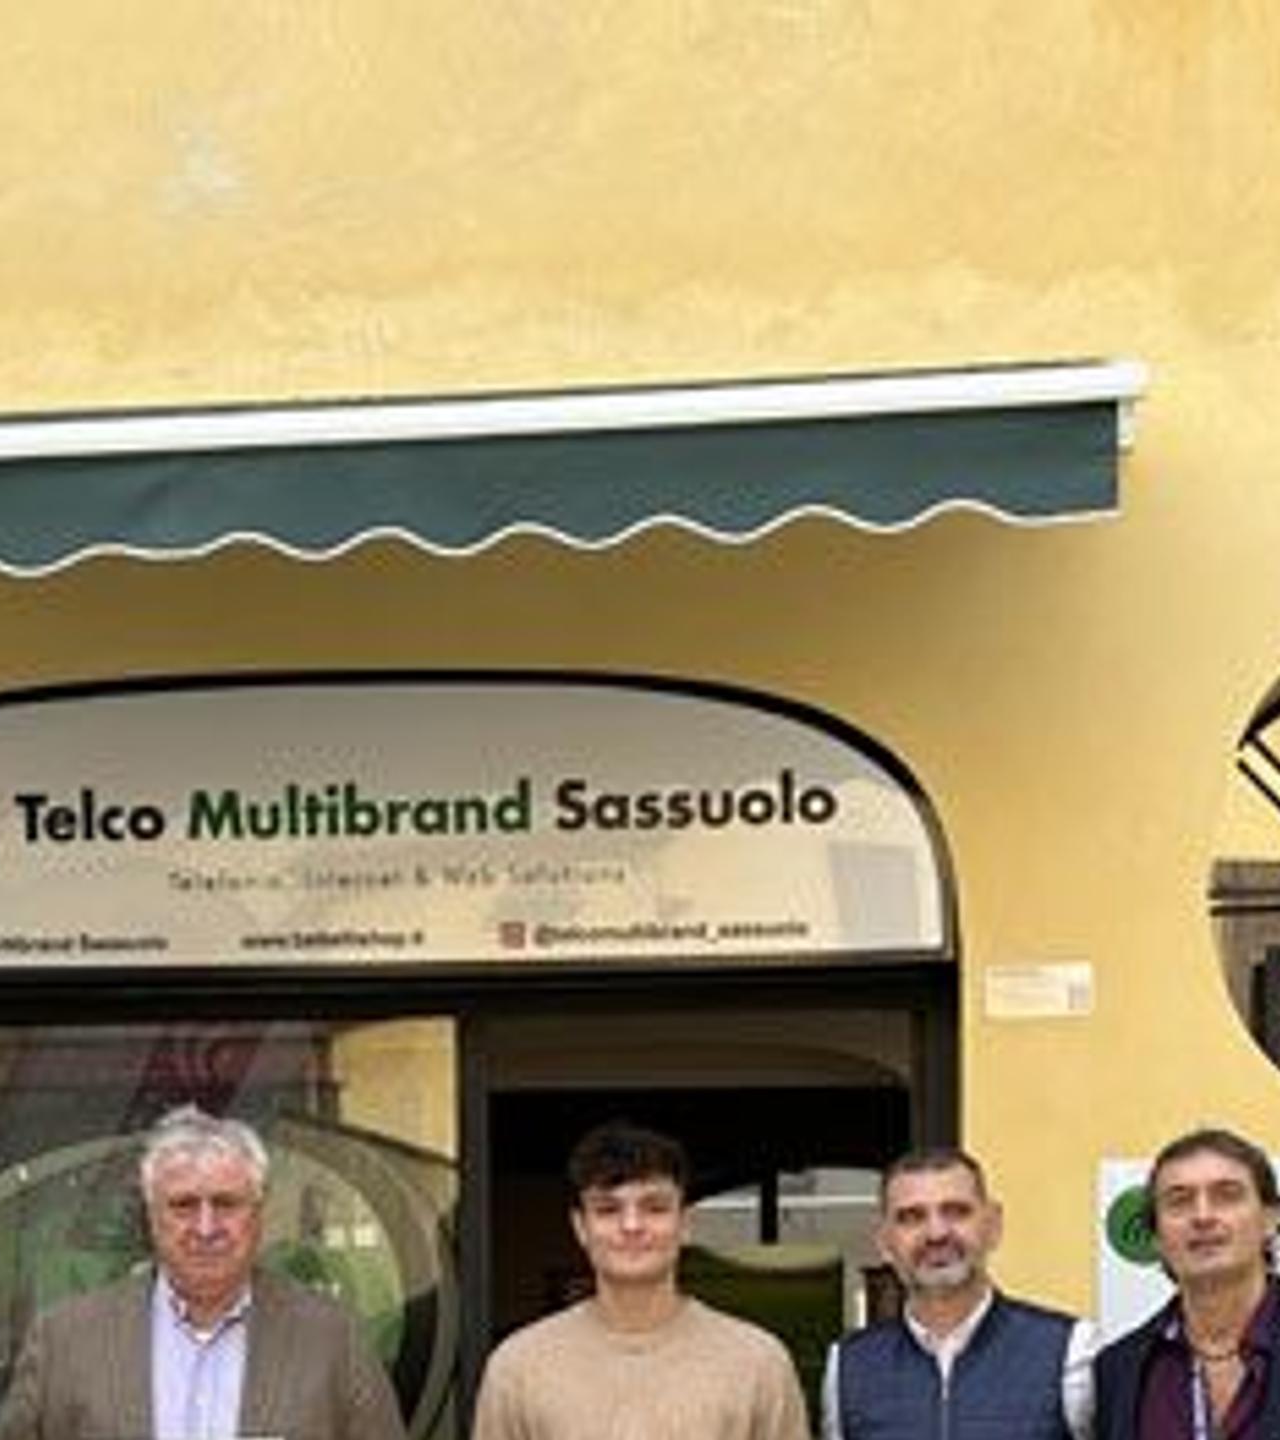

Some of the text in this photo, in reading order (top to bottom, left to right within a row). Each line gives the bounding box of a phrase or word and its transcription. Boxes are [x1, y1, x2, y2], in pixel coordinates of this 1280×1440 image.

[15, 770, 838, 842] Telco Multibrand Sassuolo
